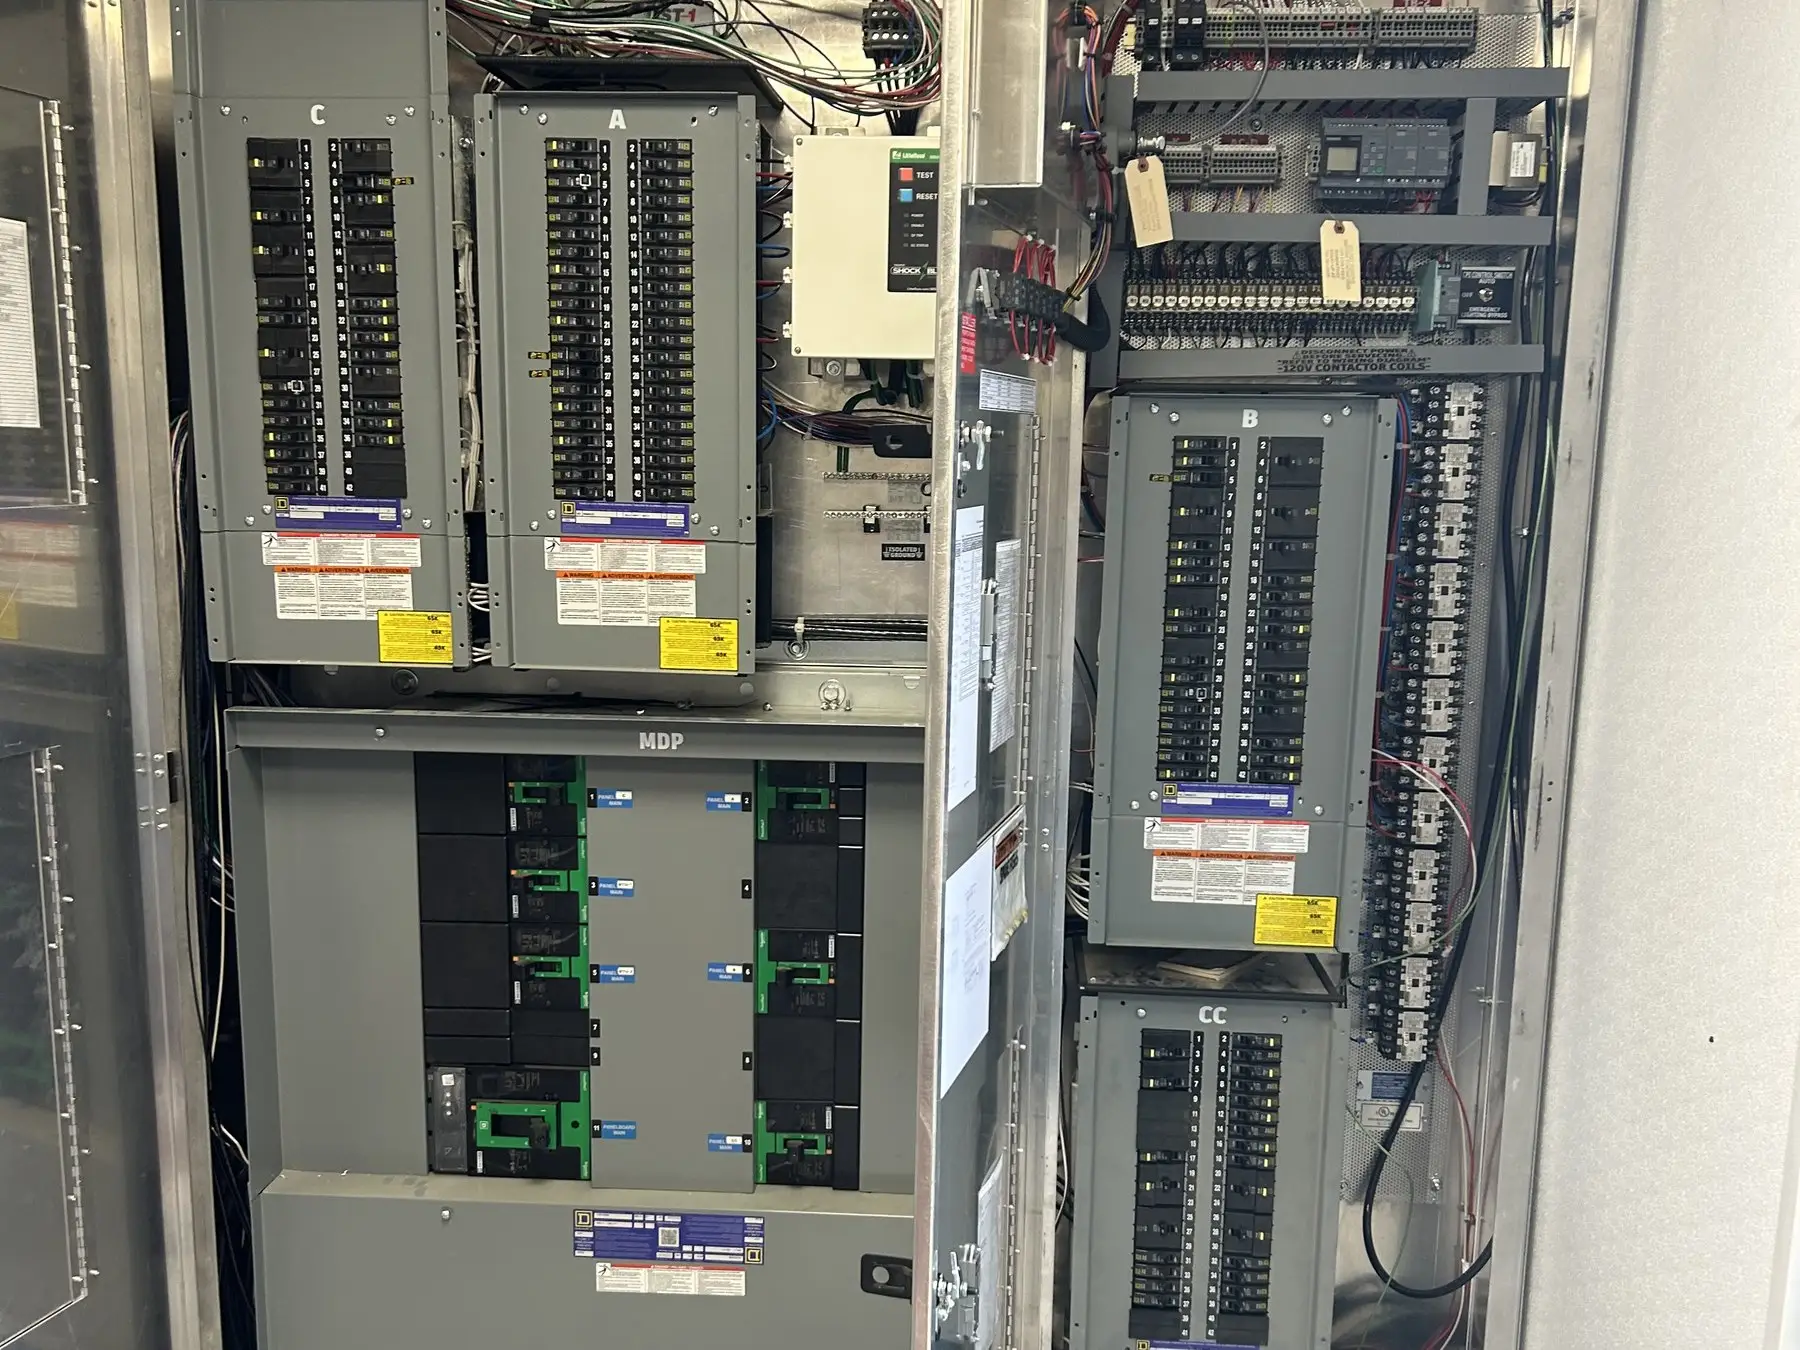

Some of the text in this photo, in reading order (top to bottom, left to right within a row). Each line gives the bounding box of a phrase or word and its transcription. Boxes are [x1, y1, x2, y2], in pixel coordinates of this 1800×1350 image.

[310, 104, 326, 124] C
[609, 110, 626, 129] A
[331, 143, 336, 151] 2
[629, 144, 635, 152] 2
[304, 162, 309, 170] 3
[332, 161, 337, 169] 4
[602, 162, 608, 171] 3
[630, 162, 635, 170] 4
[304, 179, 310, 187] 5
[332, 178, 338, 186] 6
[602, 180, 608, 189] 5
[630, 180, 635, 188] 6
[305, 196, 310, 204] 7
[333, 196, 339, 204] 8
[602, 198, 608, 206] 7
[630, 198, 636, 206] 8
[306, 214, 312, 222] 9
[333, 213, 340, 221] 10
[602, 216, 608, 224] 9
[630, 215, 637, 224] 10
[334, 230, 341, 238] 12
[630, 233, 637, 241] 12
[307, 248, 314, 256] 13
[602, 251, 609, 259] 13
[630, 250, 637, 258] 14
[603, 286, 610, 294] 17
[338, 316, 346, 324] 22
[632, 320, 639, 328] 22
[1316, 363, 1386, 372] CONTACTOR
[1242, 409, 1259, 428] B
[633, 422, 640, 430] 34
[1260, 441, 1266, 449] 2
[1258, 476, 1264, 484] 6
[1226, 510, 1232, 518] 9
[639, 732, 684, 750] MDP
[1199, 1006, 1228, 1024] CC
